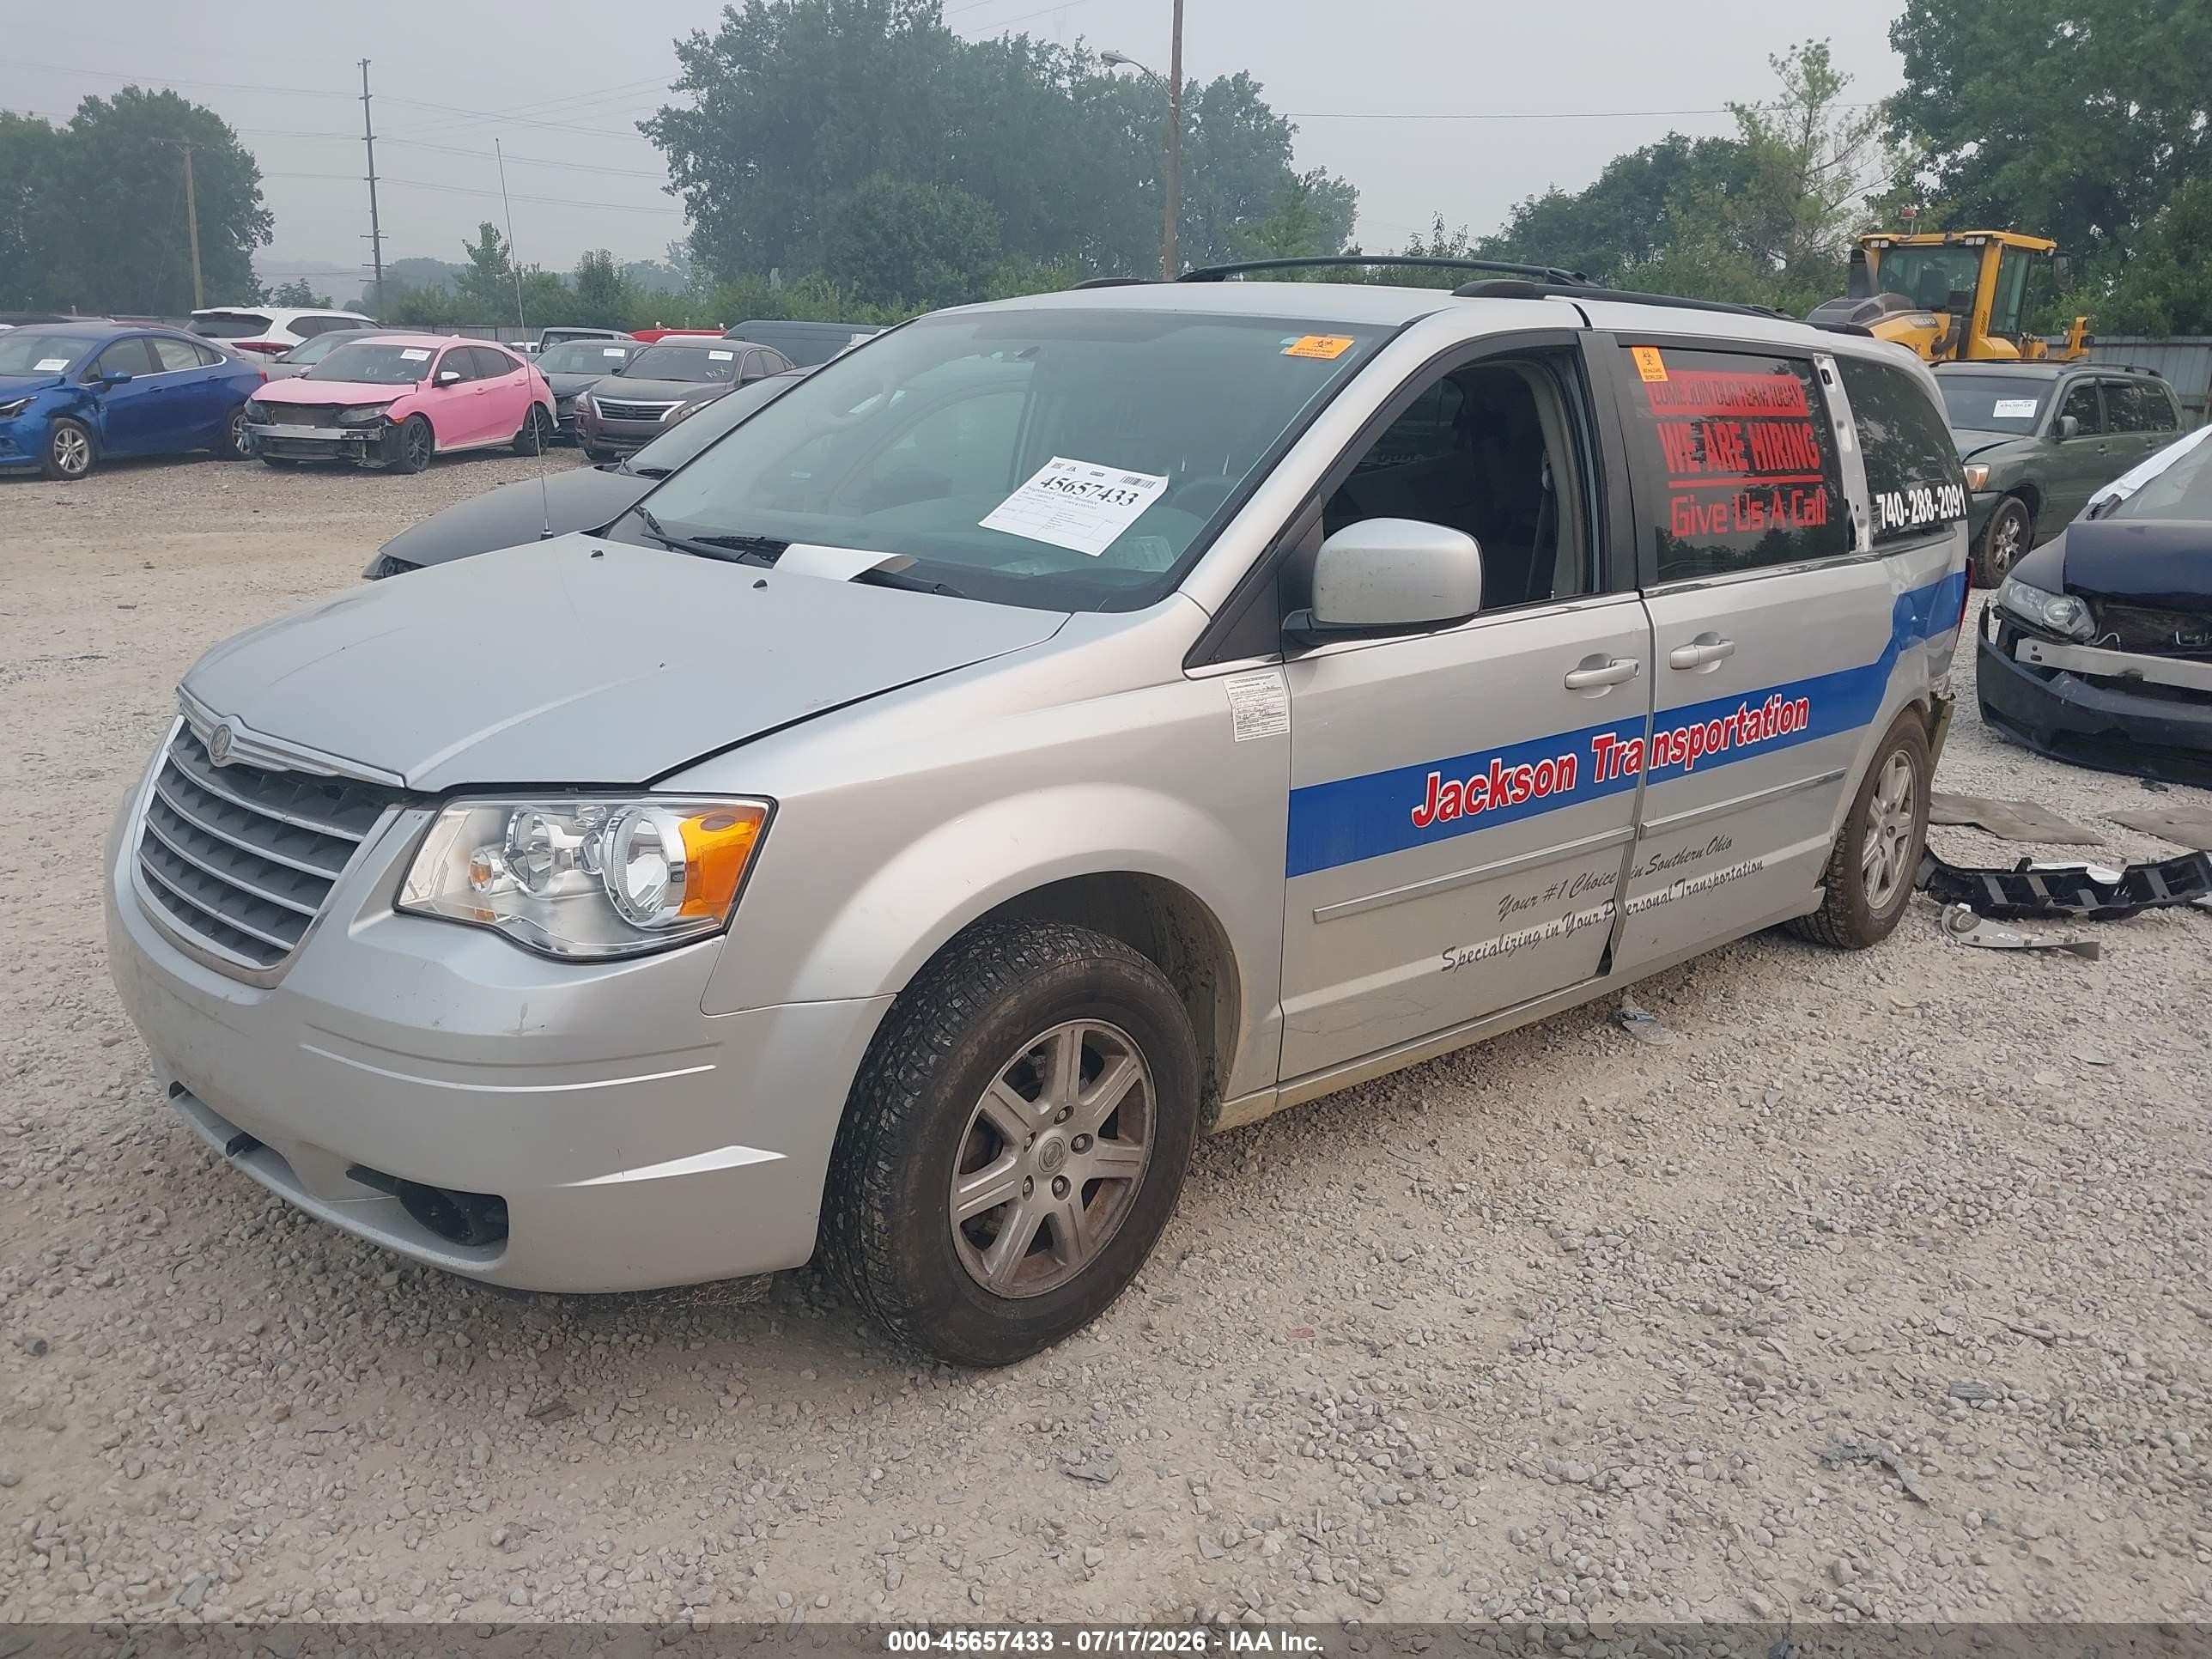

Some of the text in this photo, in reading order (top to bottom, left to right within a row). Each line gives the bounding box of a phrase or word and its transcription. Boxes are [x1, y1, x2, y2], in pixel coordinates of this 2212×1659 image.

[1689, 379, 1714, 406] JOIN
[1713, 380, 1740, 406] OUR
[1738, 381, 1770, 408] TEAM
[1768, 382, 1802, 409] TODAY
[1657, 422, 1820, 473] WE ARE HIRING
[1040, 476, 1139, 506] 45657433
[1671, 487, 1827, 537] Give Us A Call
[1875, 483, 1967, 529] 740-288-2091
[1412, 694, 1810, 829] Jackson Transportation
[1498, 834, 1733, 922] Your #1 Choice in Southern Ohio
[1441, 860, 1764, 974] Specializing in Your Personal Transportation
